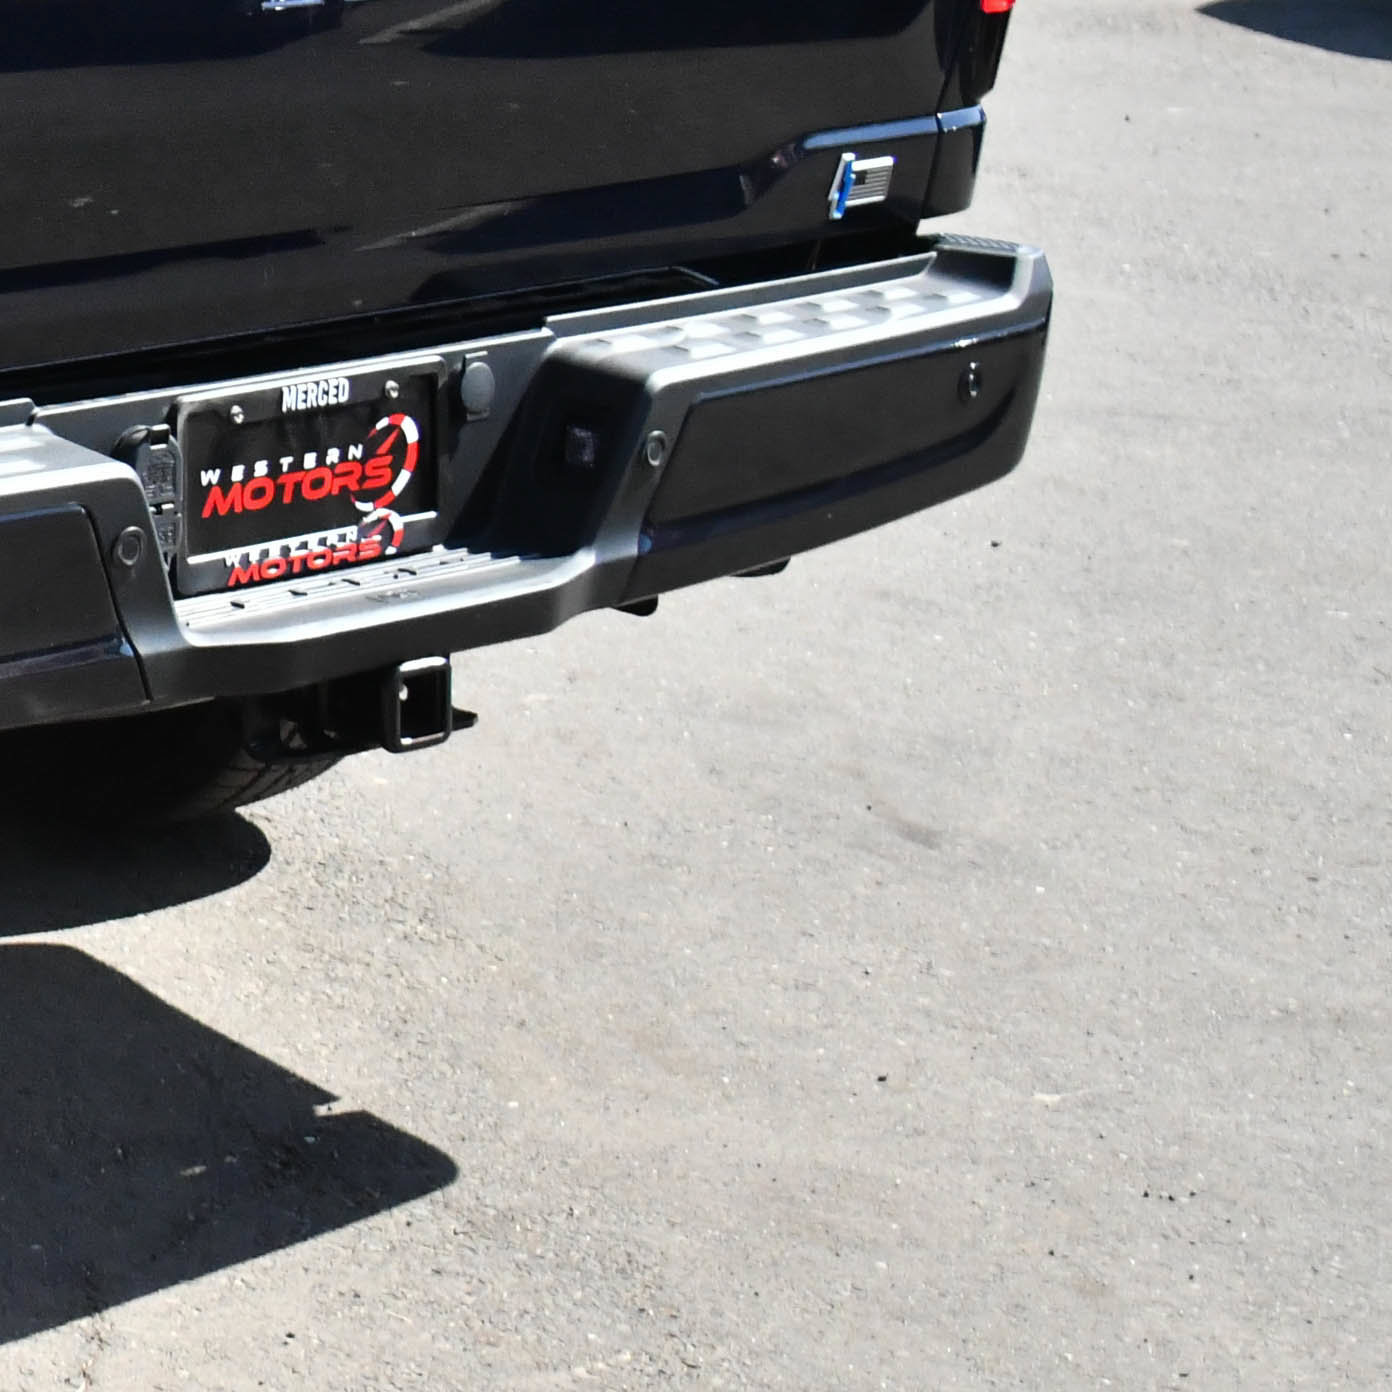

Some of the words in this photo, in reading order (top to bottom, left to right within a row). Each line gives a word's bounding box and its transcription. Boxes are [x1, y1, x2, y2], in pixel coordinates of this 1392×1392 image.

[281, 376, 350, 413] MERCED
[200, 444, 364, 486] WESTERN
[200, 453, 394, 519] MOTORS
[226, 537, 383, 587] MOTORS
